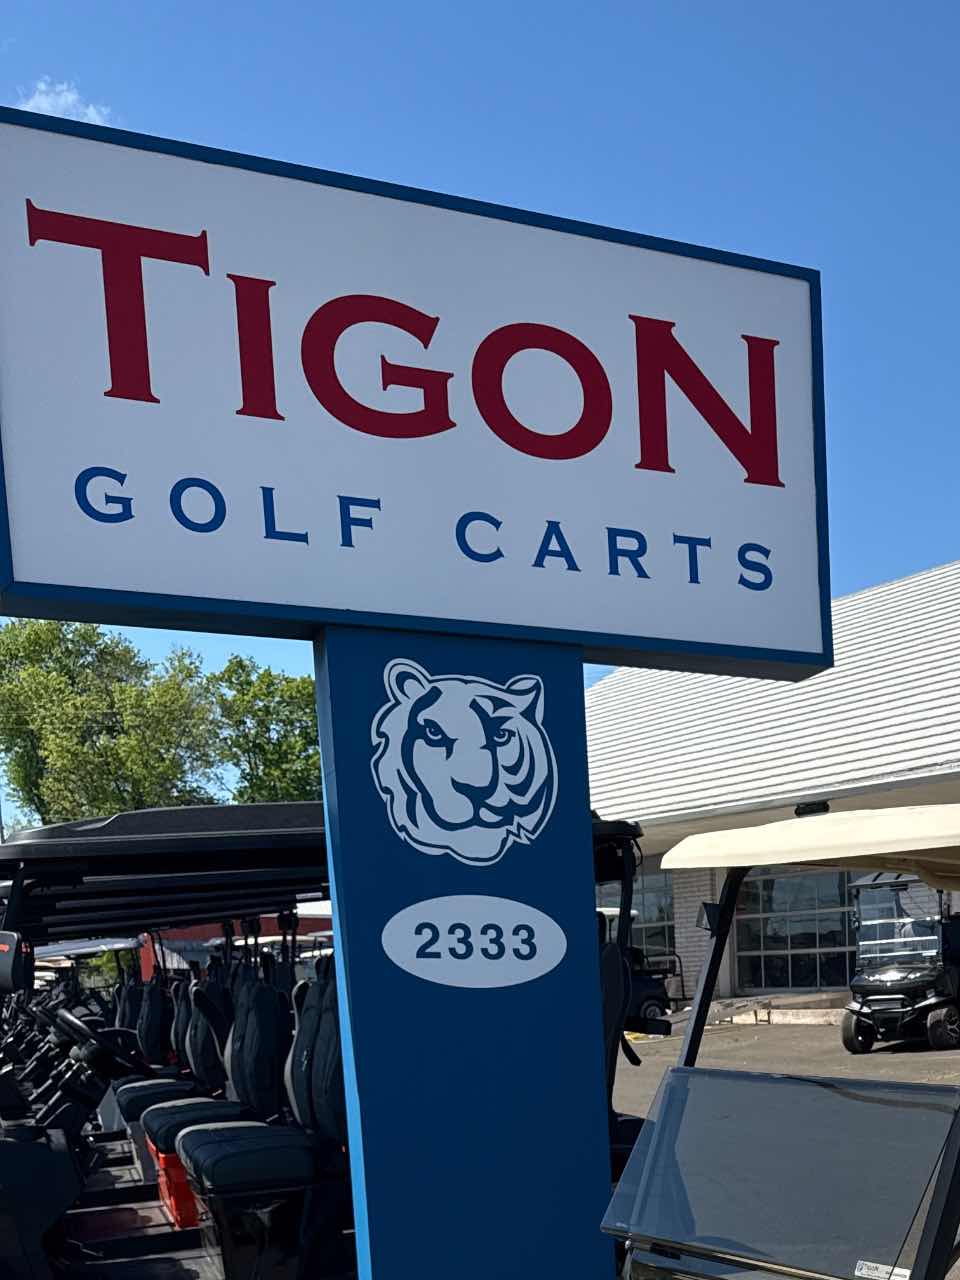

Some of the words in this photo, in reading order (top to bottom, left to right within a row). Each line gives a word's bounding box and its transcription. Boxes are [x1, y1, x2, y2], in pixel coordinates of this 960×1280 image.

[24, 198, 786, 488] TIGON
[74, 466, 382, 549] GOLF
[455, 511, 774, 592] CARTS
[414, 921, 538, 961] 2333
